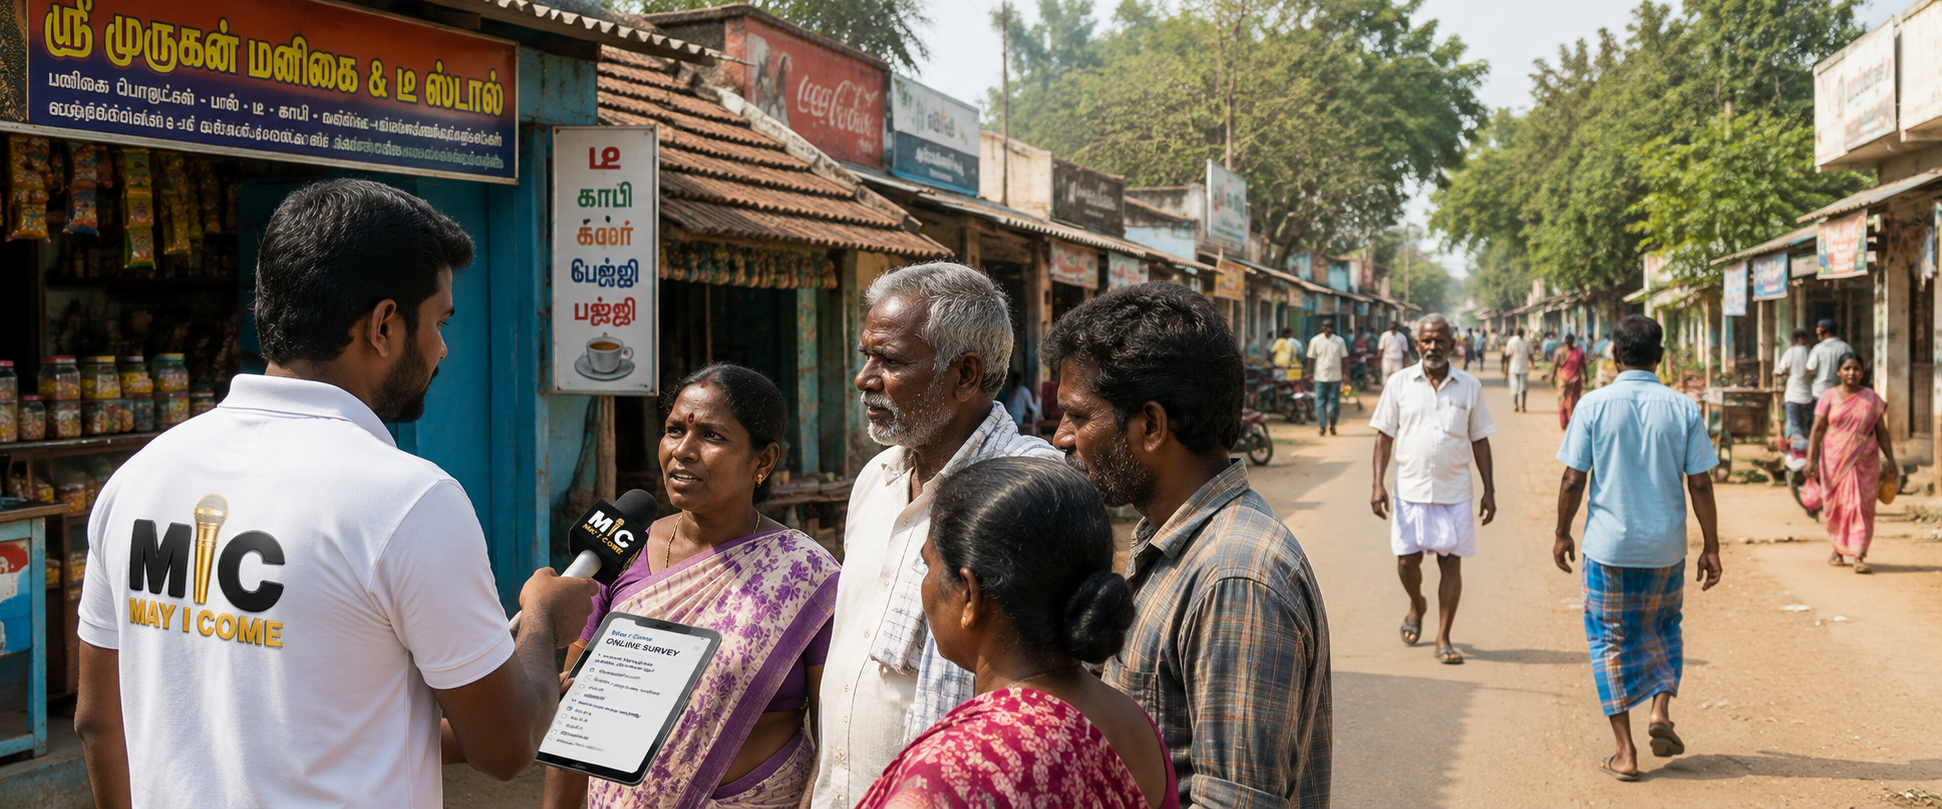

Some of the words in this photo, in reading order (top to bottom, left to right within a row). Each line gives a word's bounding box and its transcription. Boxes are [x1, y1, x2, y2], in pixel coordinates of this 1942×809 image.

[105, 15, 240, 73] முருகன்
[248, 36, 359, 93] மனிகை
[368, 60, 388, 98] &
[397, 68, 418, 103] டீ
[426, 60, 504, 116] ஸ்டால்
[211, 93, 239, 112] பால்
[278, 104, 309, 122] காபி
[589, 146, 621, 170] டீ
[577, 181, 633, 208] காபி
[574, 296, 636, 327] பஜ்ஜி
[129, 597, 176, 630] MAY
[182, 606, 191, 634] I
[196, 609, 285, 648] COME
[606, 637, 641, 651] ONLINE
[642, 644, 681, 658] SURVEY
